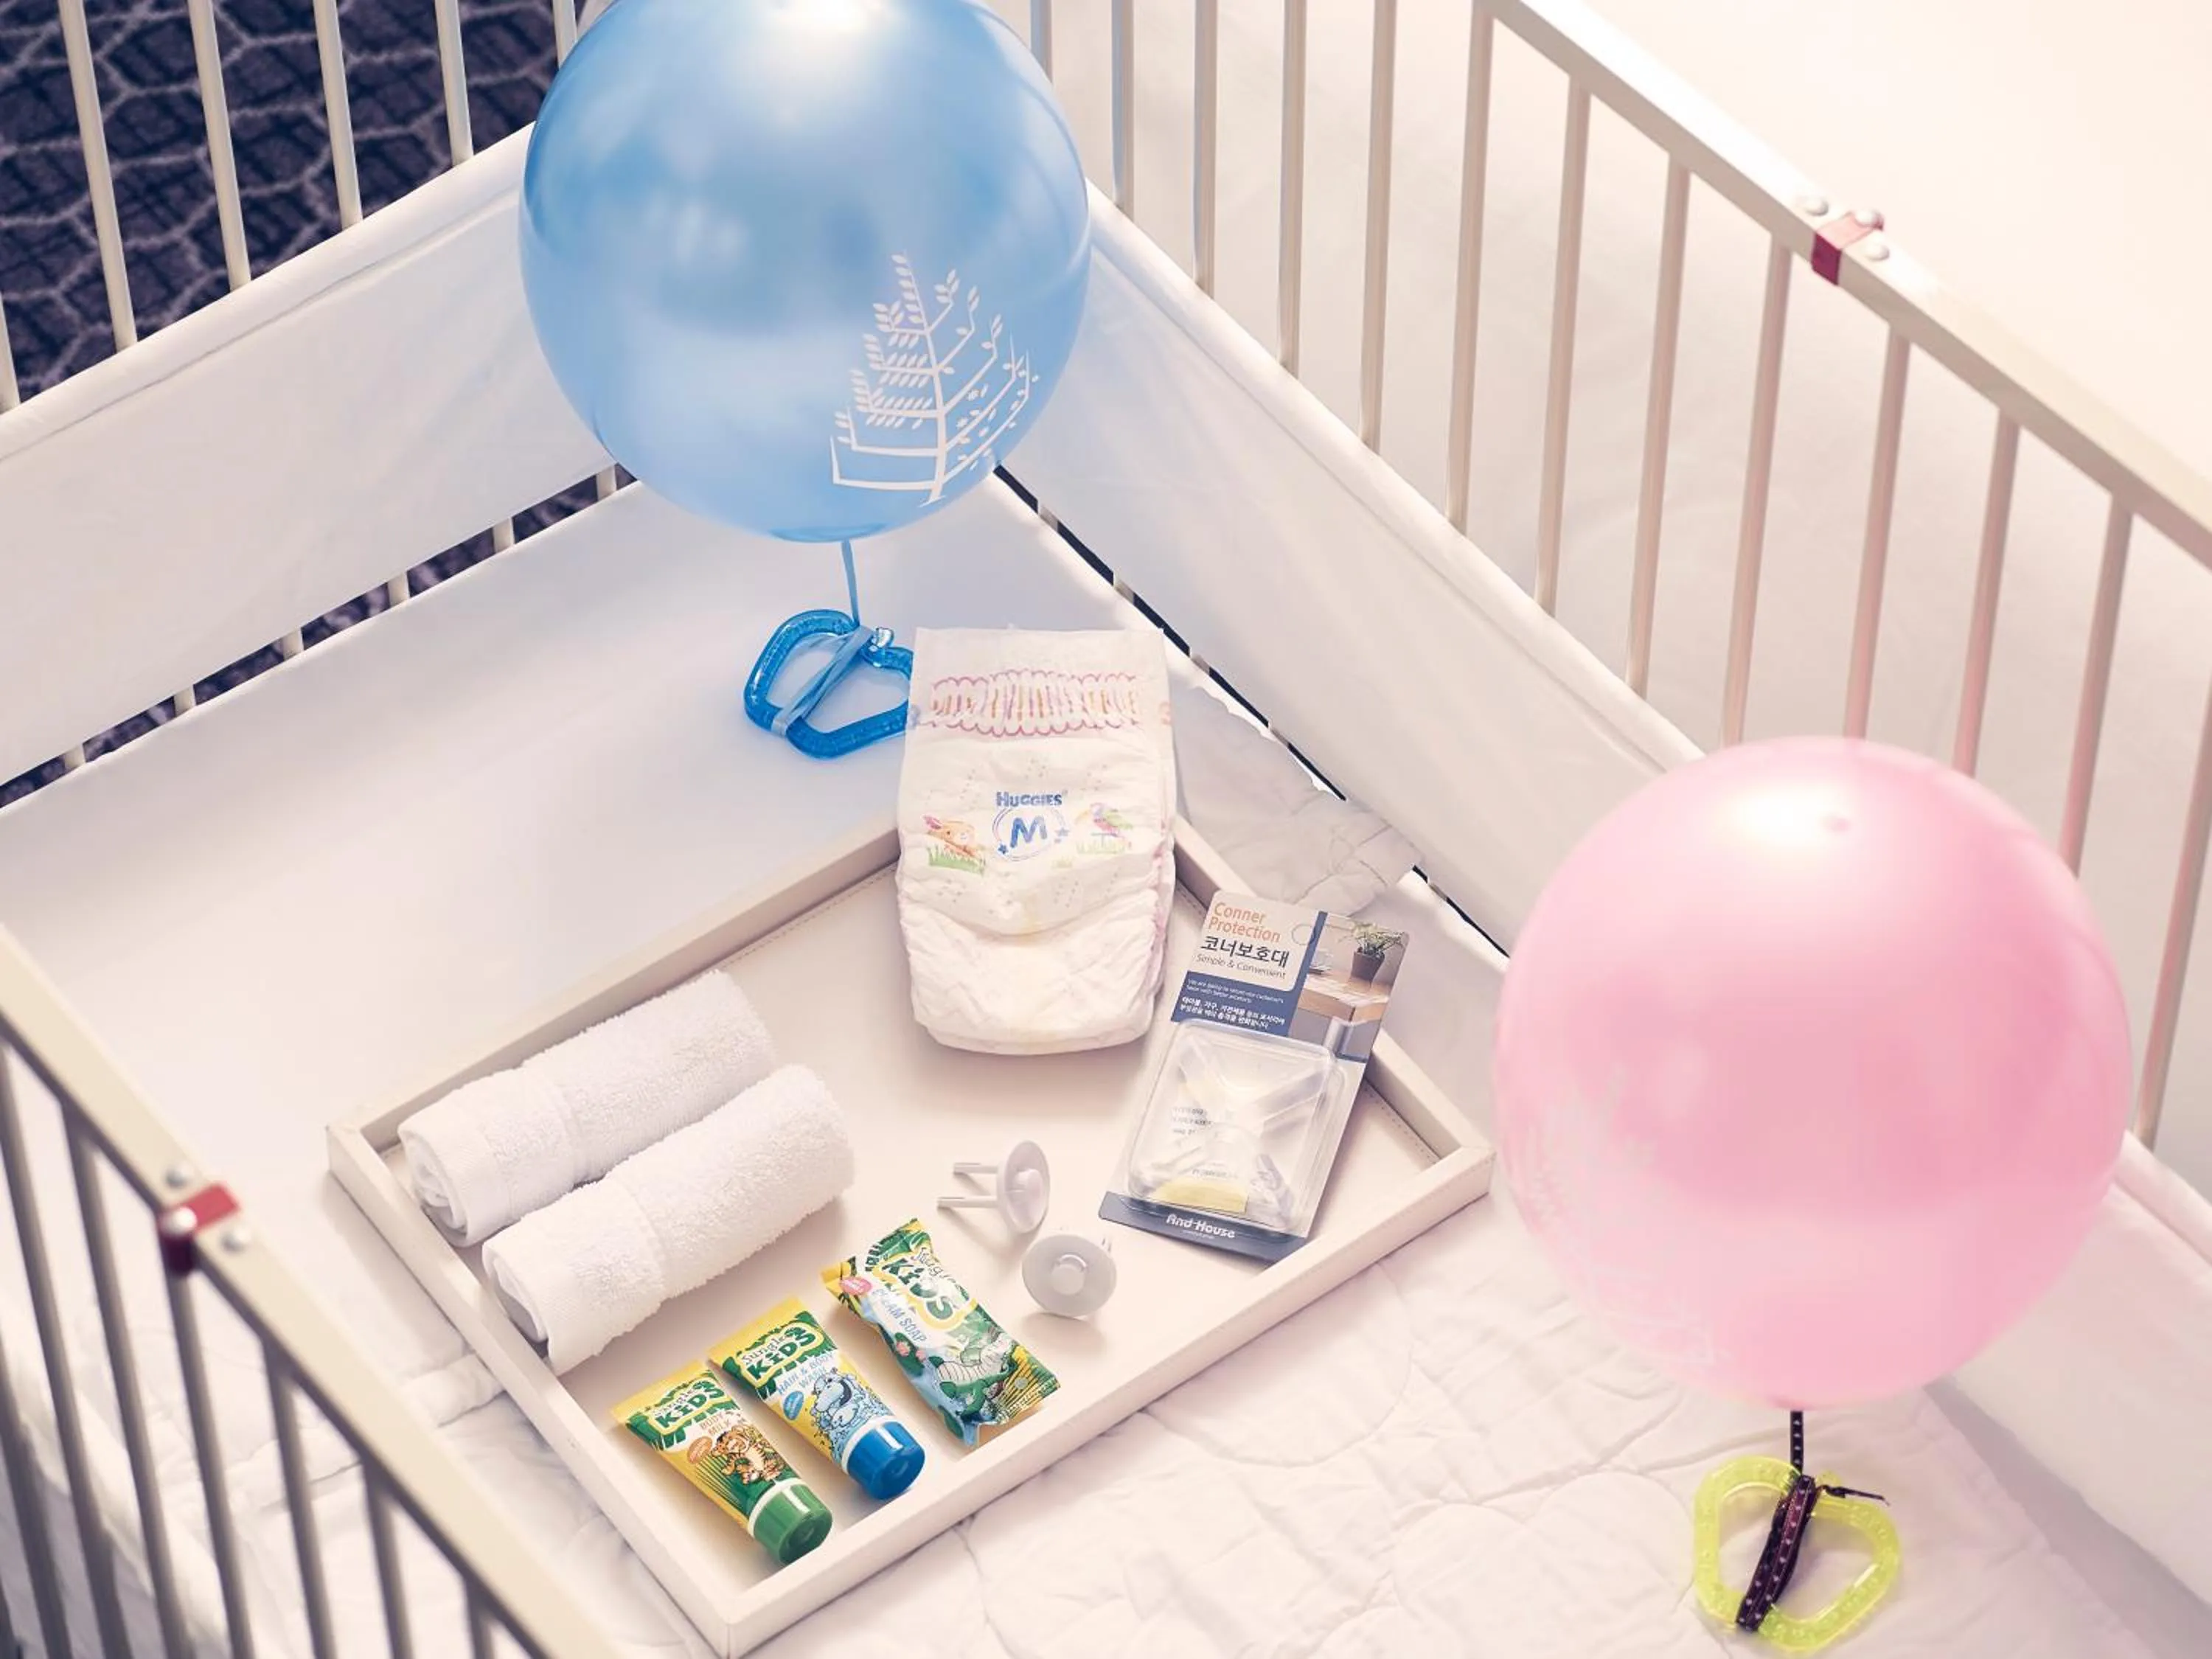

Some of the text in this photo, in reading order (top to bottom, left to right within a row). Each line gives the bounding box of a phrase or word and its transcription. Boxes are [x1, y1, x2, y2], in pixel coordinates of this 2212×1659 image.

[1010, 815, 1047, 848] M
[1214, 902, 1266, 925] Conner
[1208, 917, 1281, 943] Protection
[1200, 936, 1290, 968] 코너보호대
[1196, 953, 1287, 979] Simple & Convenient
[899, 1318, 927, 1342] SOAP
